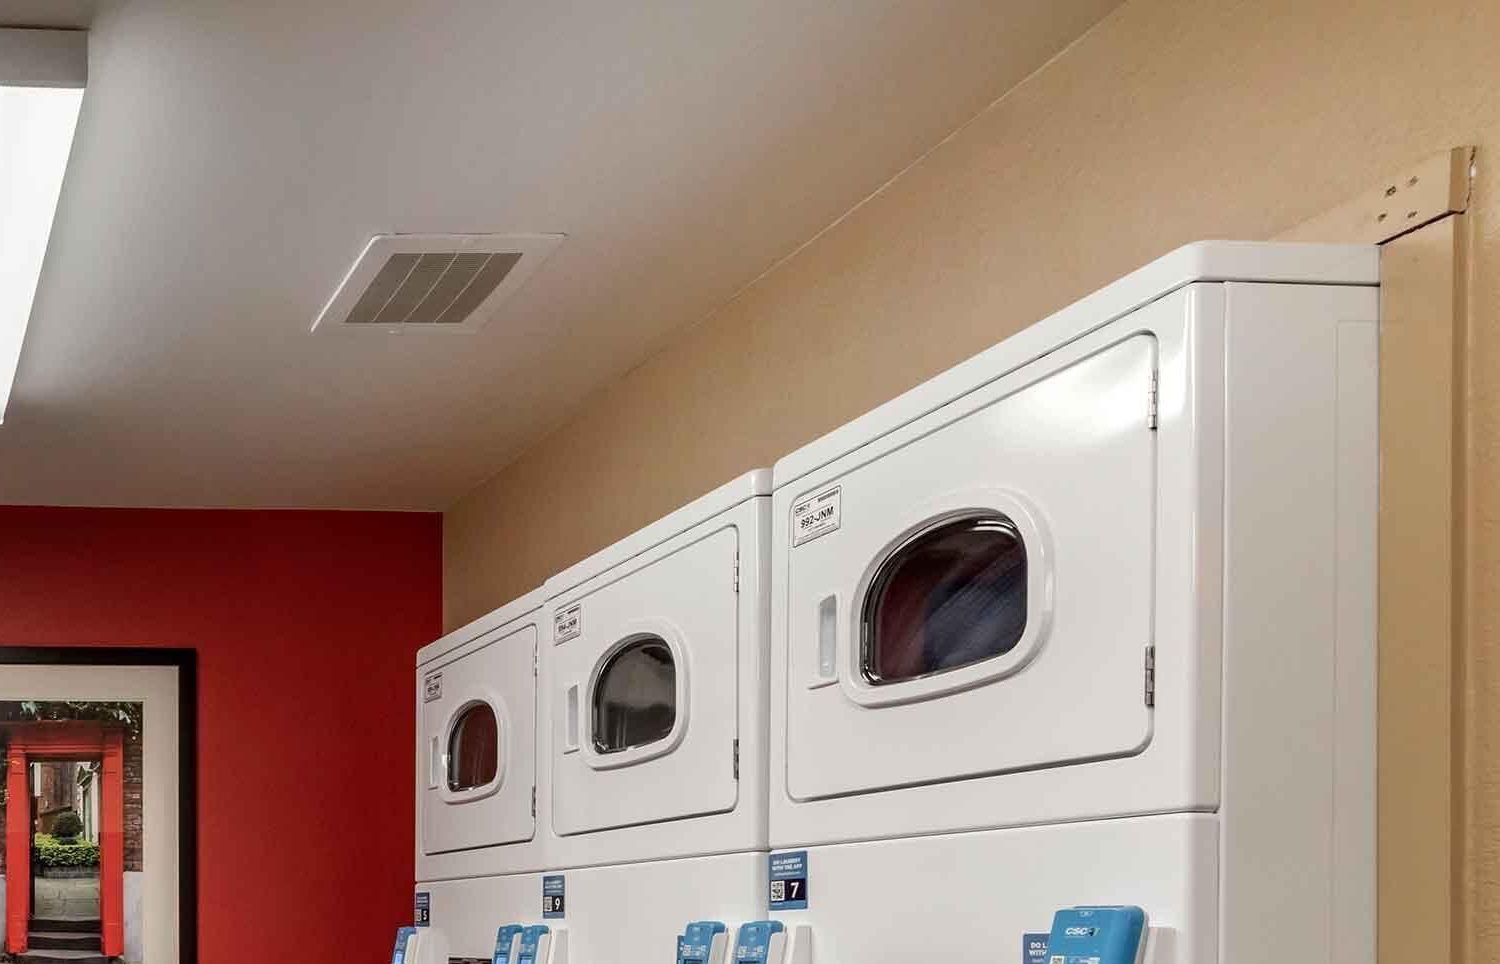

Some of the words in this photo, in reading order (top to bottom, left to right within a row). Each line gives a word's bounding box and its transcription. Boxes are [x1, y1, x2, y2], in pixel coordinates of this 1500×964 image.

[790, 881, 800, 899] 7
[555, 897, 561, 911] 9
[1065, 927, 1088, 937] CSC
[1030, 941, 1042, 949] DO
